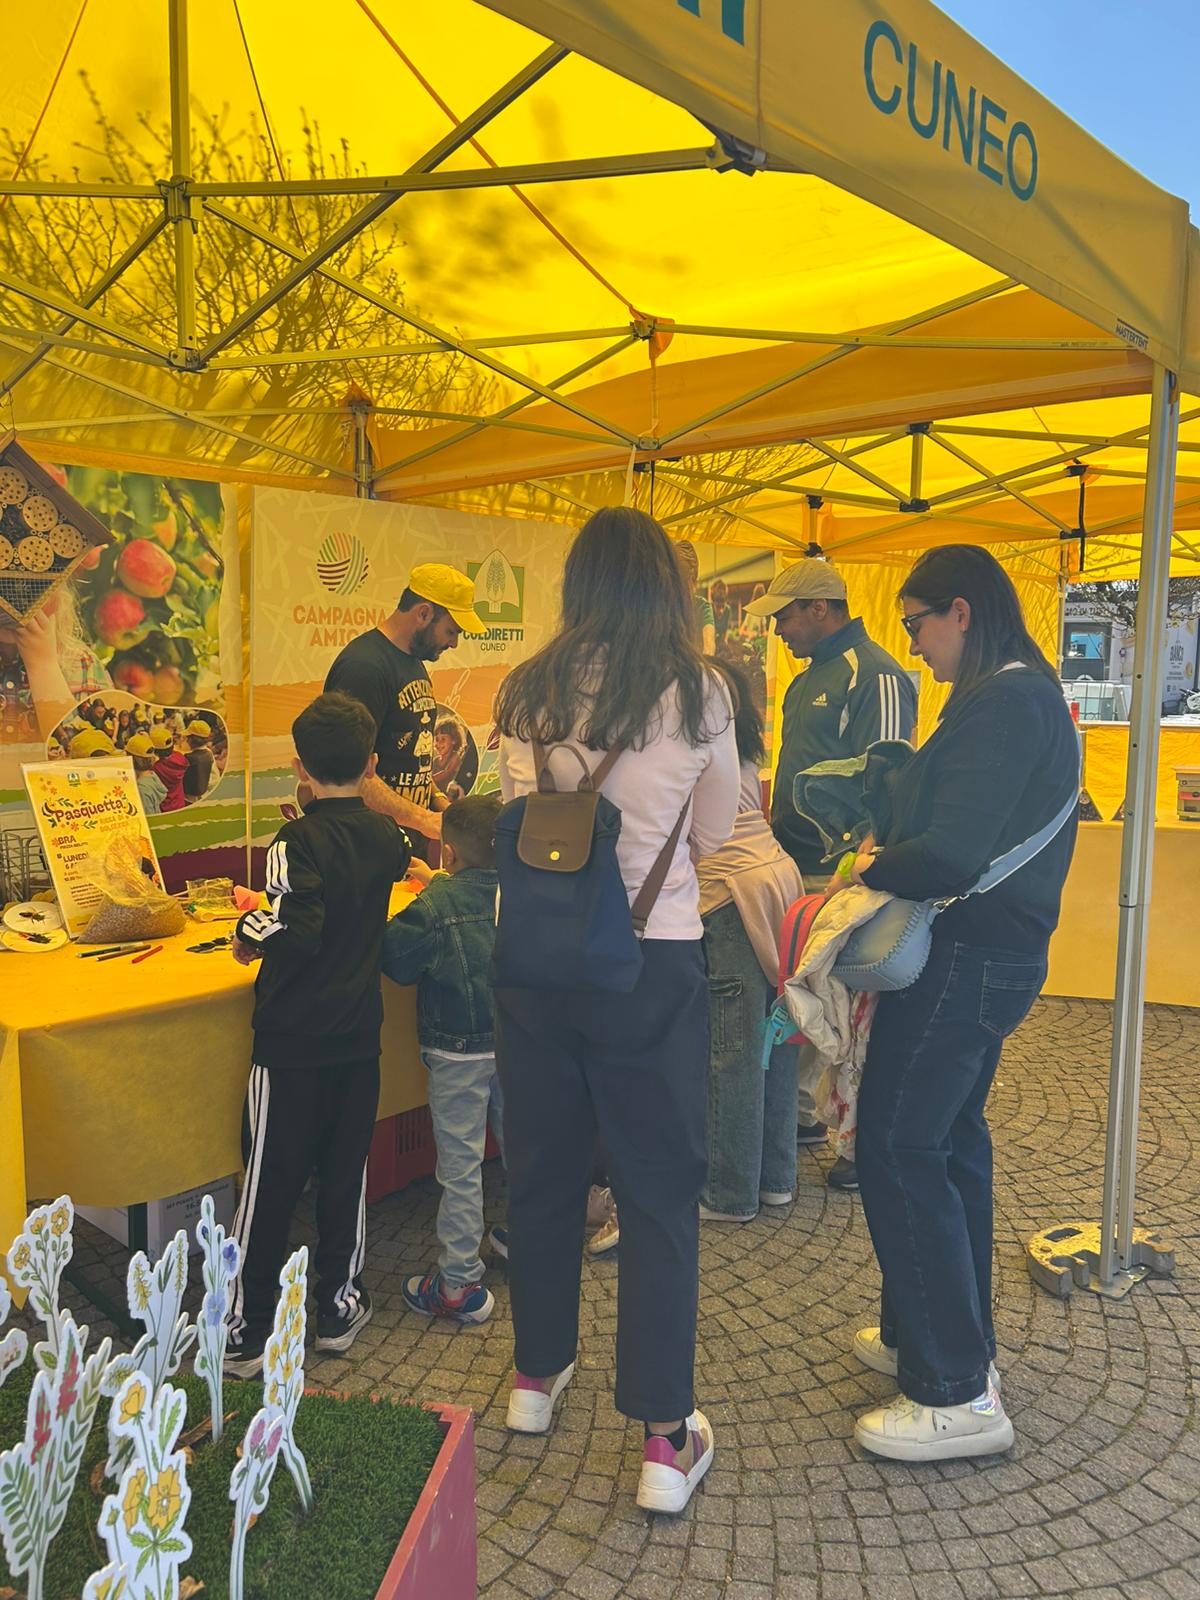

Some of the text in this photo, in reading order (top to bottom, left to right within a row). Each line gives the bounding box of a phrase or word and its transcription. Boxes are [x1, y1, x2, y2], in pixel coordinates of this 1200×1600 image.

[864, 20, 1038, 201] CUNEO
[480, 642, 506, 652] CUNEO
[398, 772, 412, 785] LE
[55, 799, 124, 822] Pasquetta
[57, 835, 77, 845] BRA
